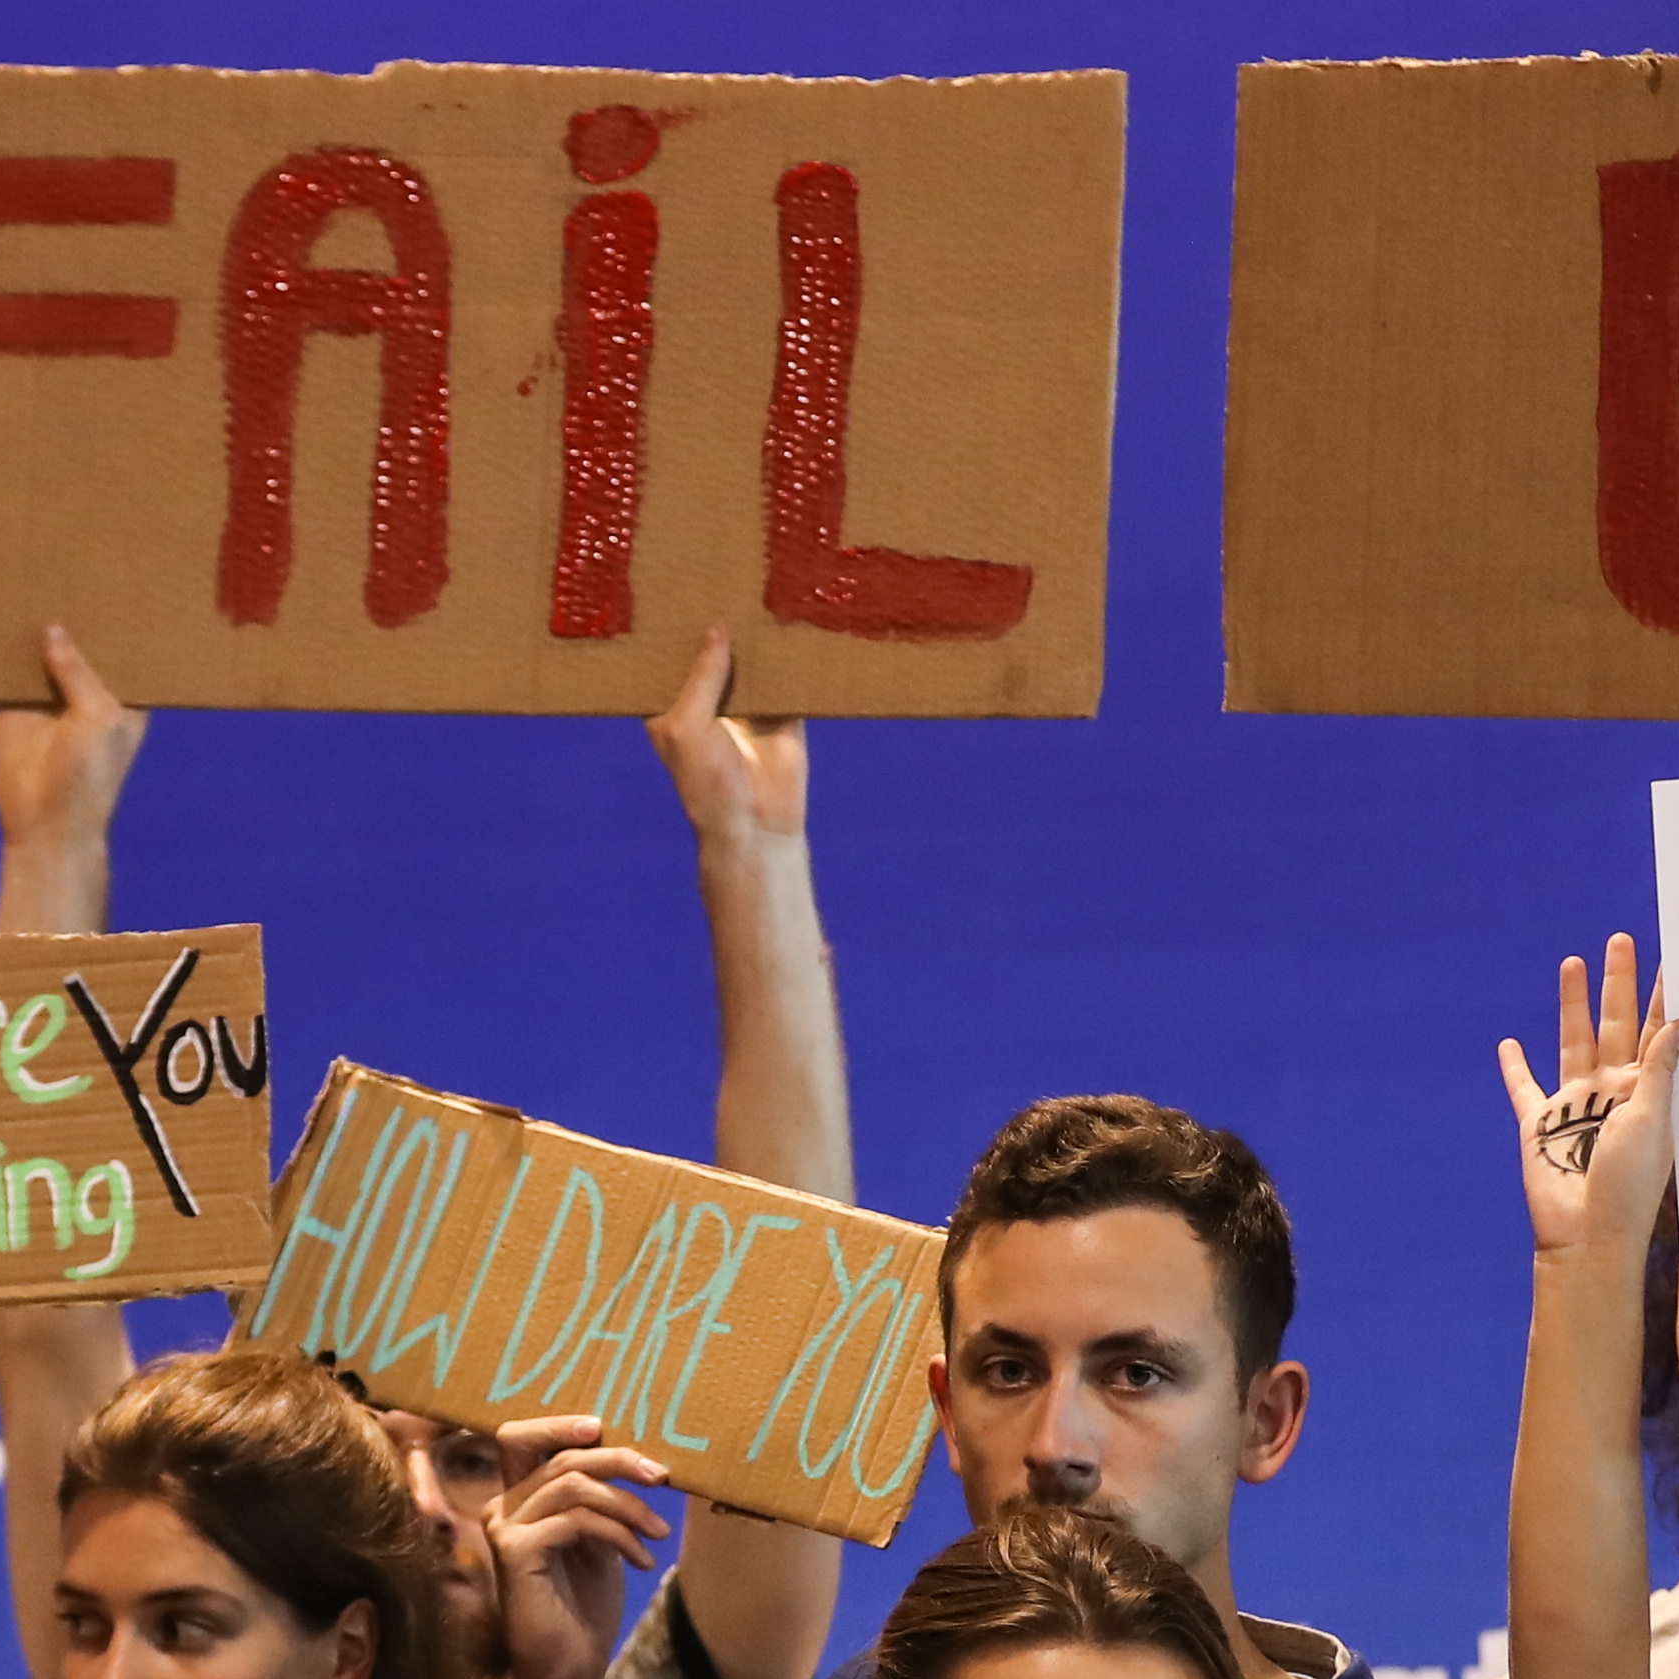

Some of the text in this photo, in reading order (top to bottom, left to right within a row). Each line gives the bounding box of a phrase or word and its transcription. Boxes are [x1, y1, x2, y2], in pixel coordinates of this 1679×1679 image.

[250, 1088, 934, 1499] HOW DARE YOU
